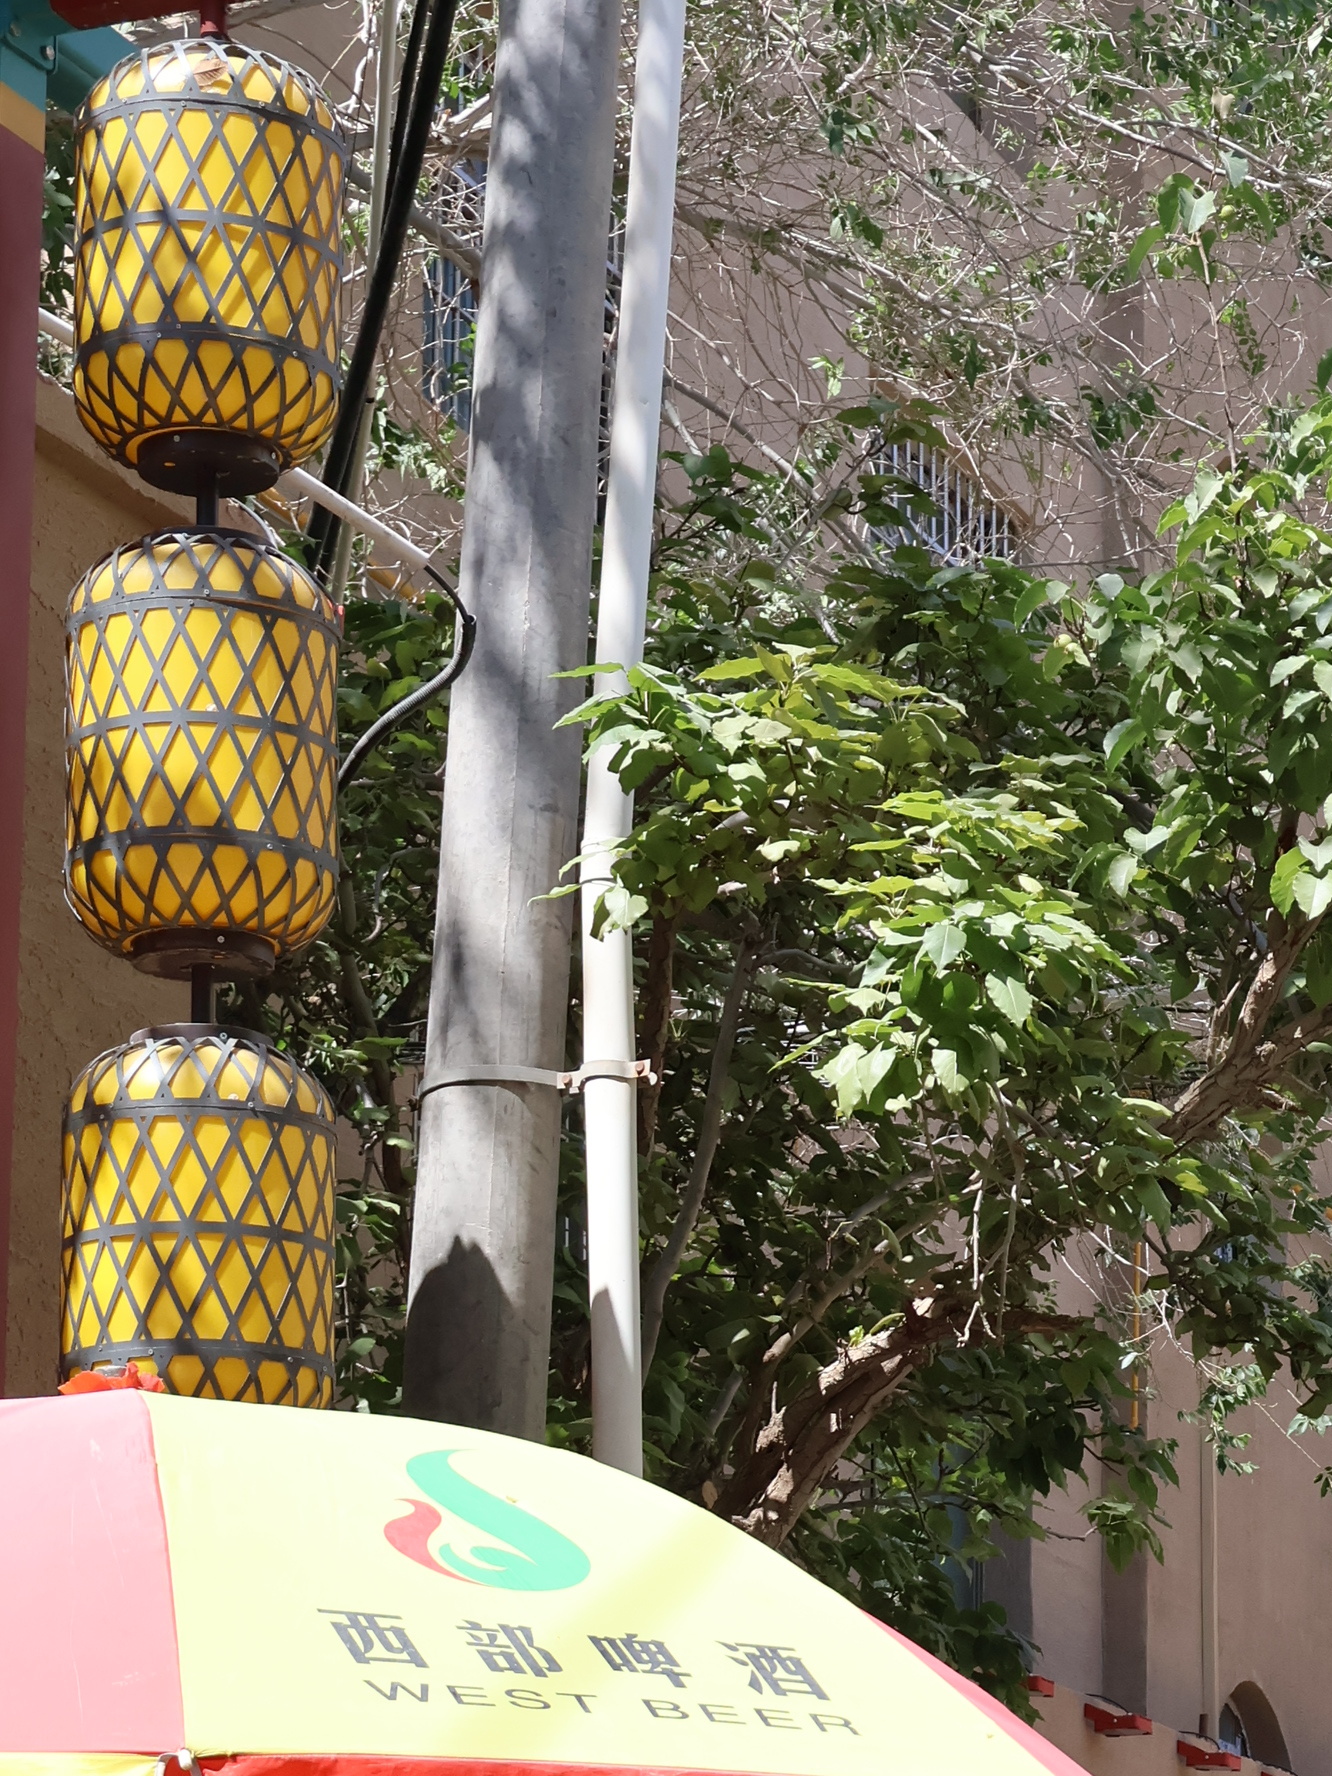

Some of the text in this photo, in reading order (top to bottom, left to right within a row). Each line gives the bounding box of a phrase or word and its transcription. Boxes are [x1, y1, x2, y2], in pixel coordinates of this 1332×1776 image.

[316, 1607, 832, 1702] 西部啤酒
[362, 1679, 863, 1736] WEST BEER
